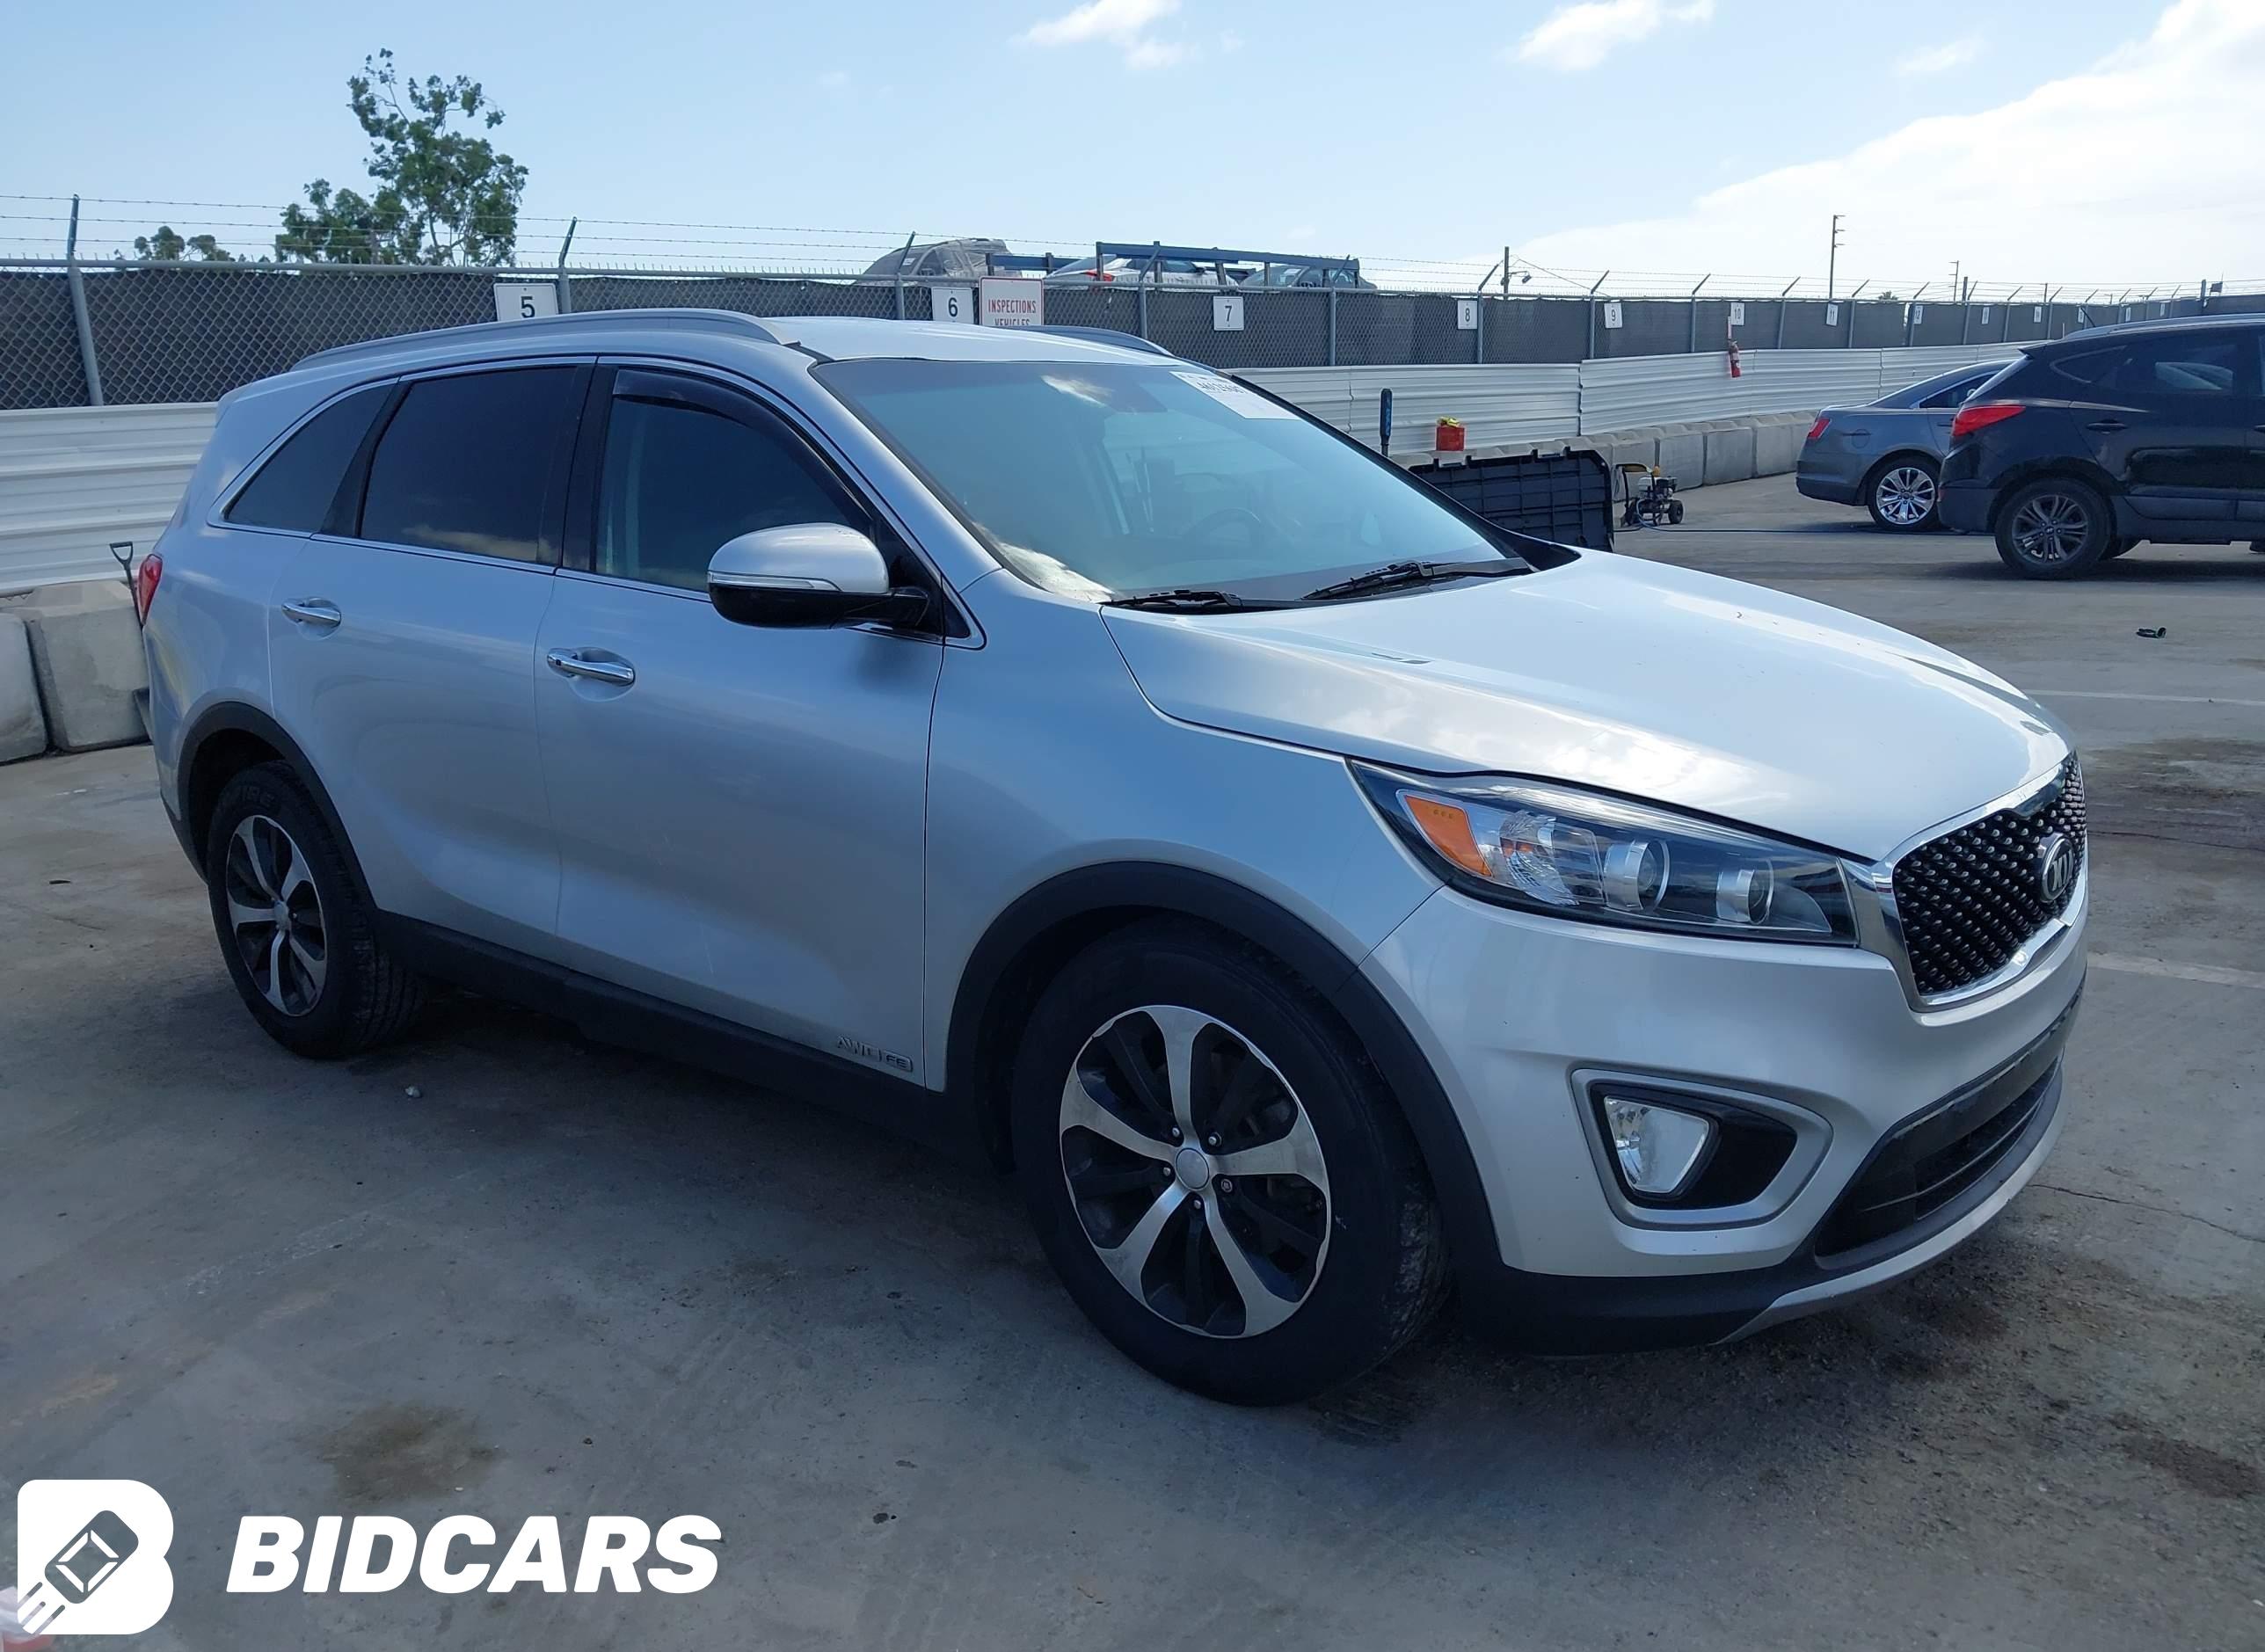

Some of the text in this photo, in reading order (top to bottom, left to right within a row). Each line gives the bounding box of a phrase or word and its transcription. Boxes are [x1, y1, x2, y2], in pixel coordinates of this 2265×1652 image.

[521, 295, 535, 317] 5
[948, 297, 958, 317] 6
[987, 299, 1037, 314] INSPECTIONS
[1224, 305, 1233, 322] 7
[1465, 308, 1471, 322] 8
[1611, 309, 1616, 322] 9
[1734, 308, 1741, 320] 10
